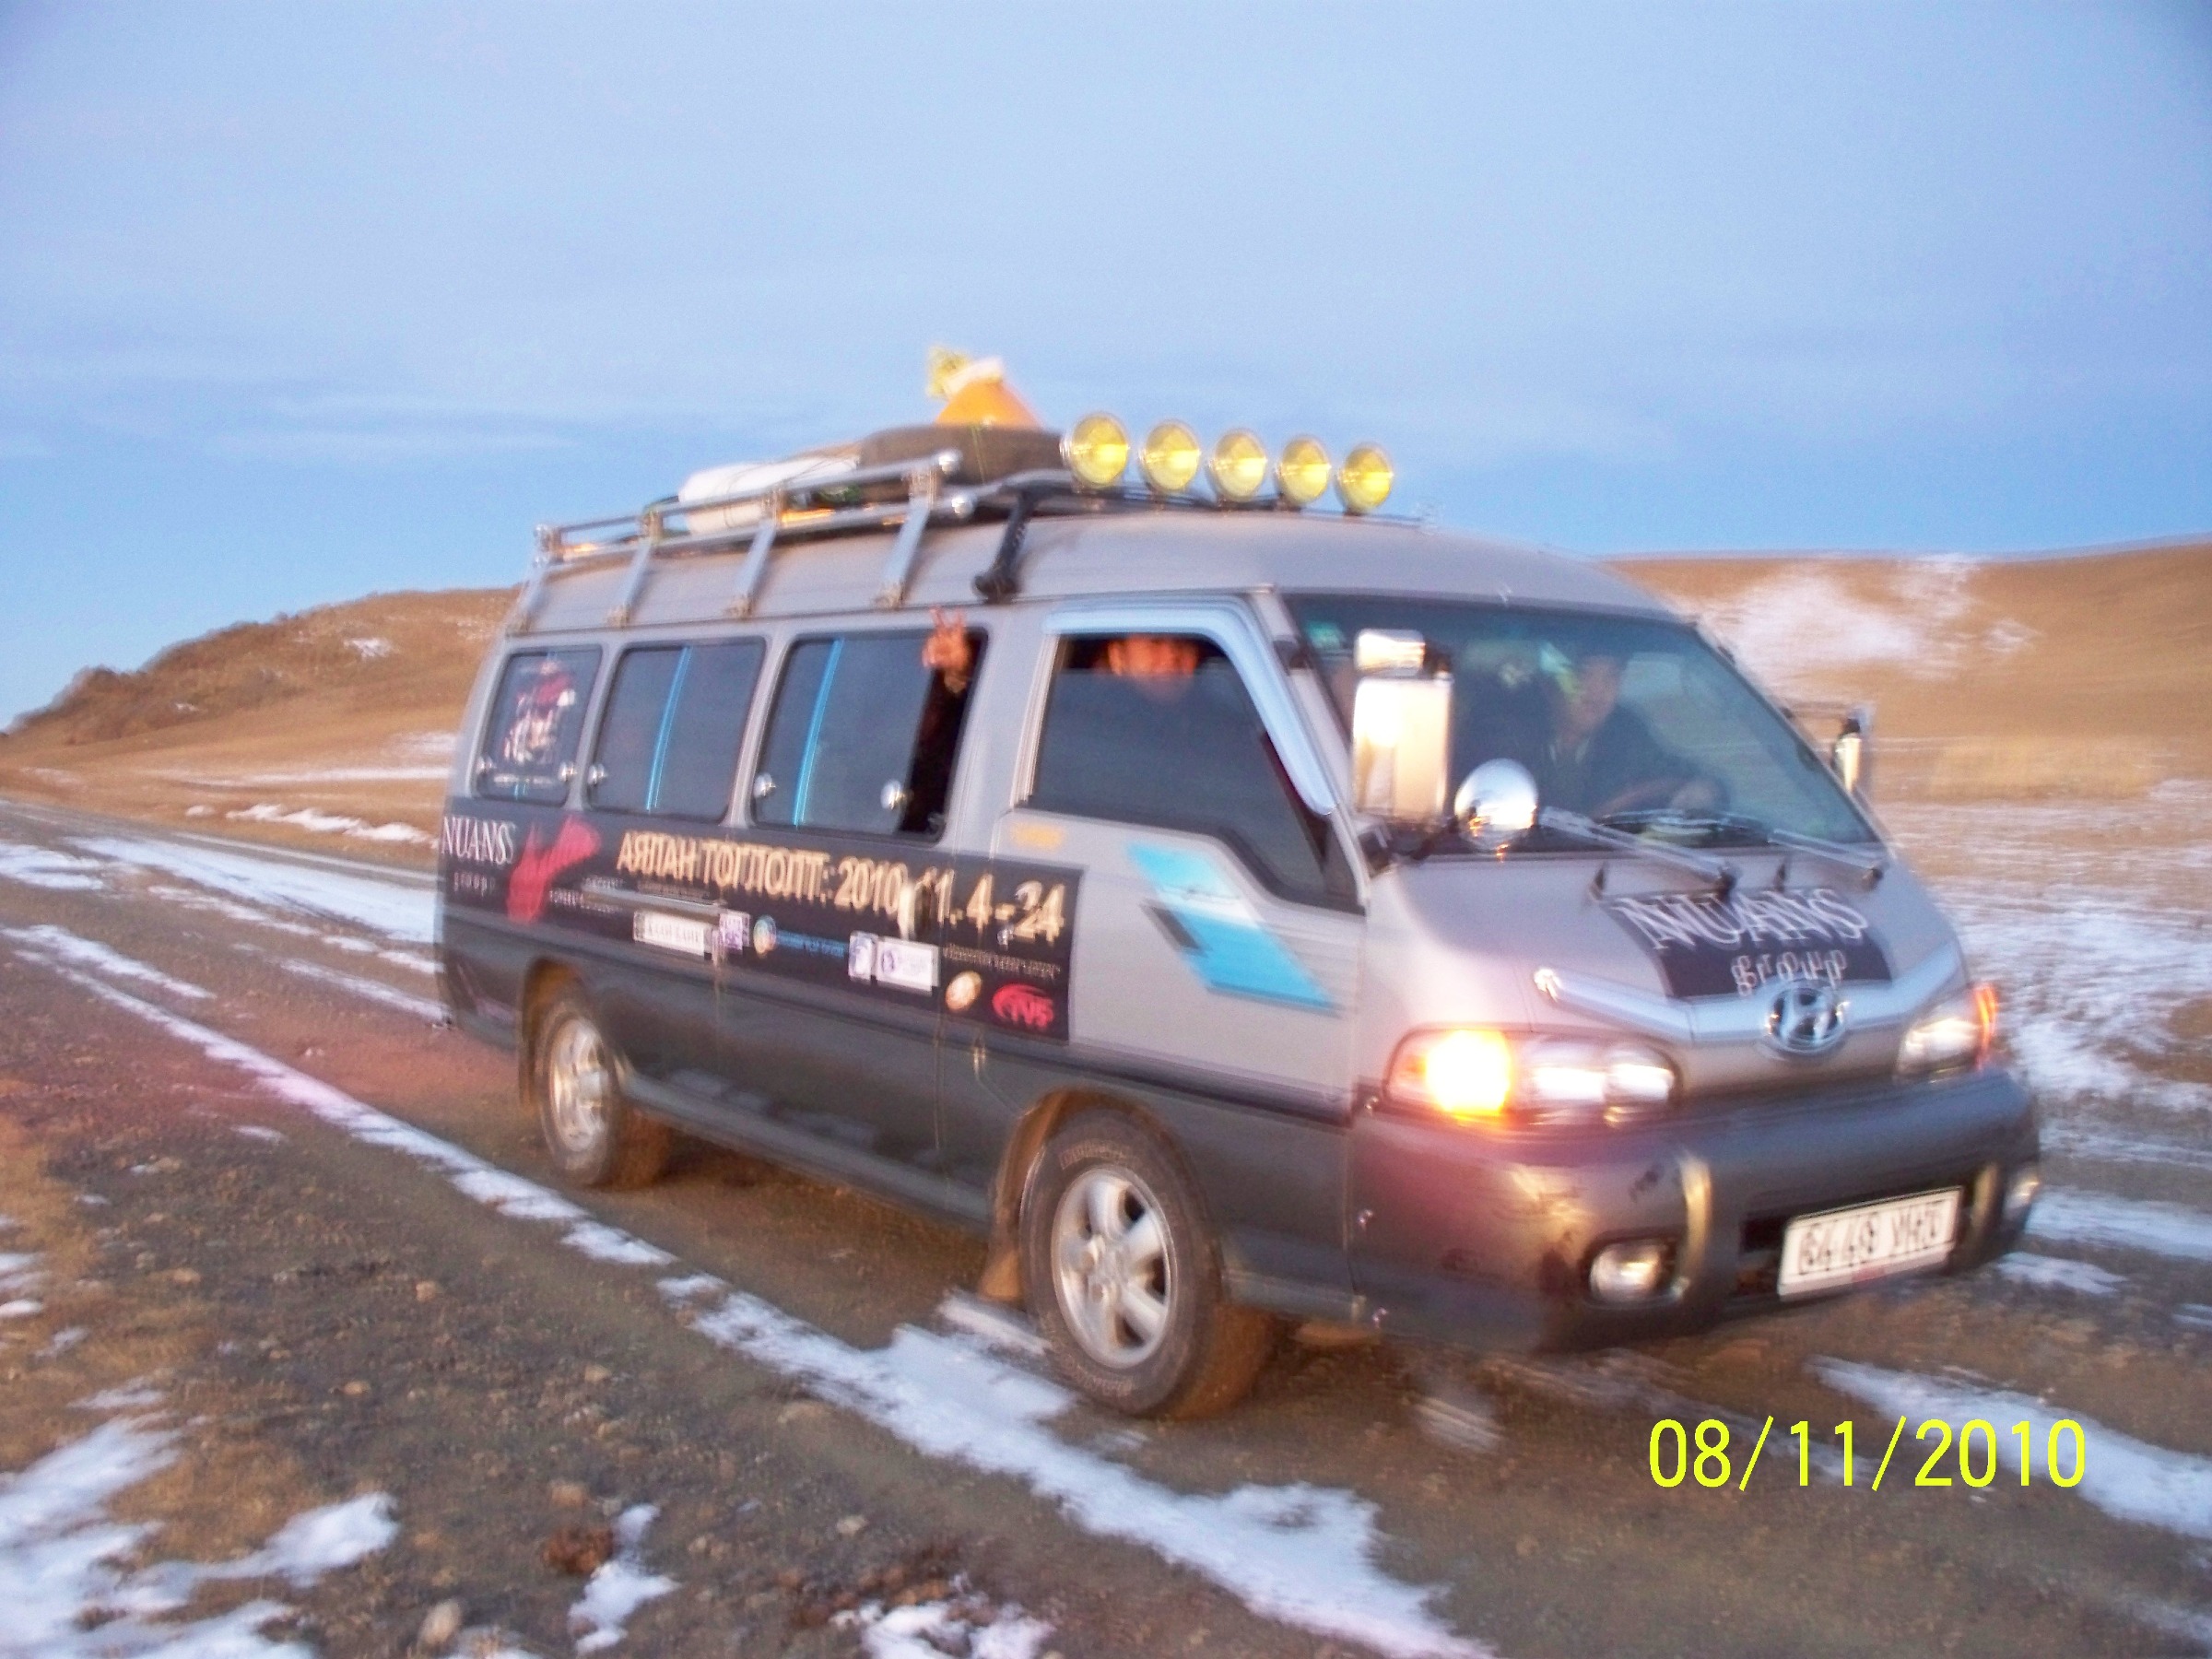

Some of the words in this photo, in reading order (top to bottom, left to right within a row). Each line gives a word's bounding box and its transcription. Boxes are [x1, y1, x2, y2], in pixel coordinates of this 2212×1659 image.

[441, 815, 514, 864] NUANS
[1613, 888, 1869, 950] NUANS
[1731, 950, 1846, 996] group
